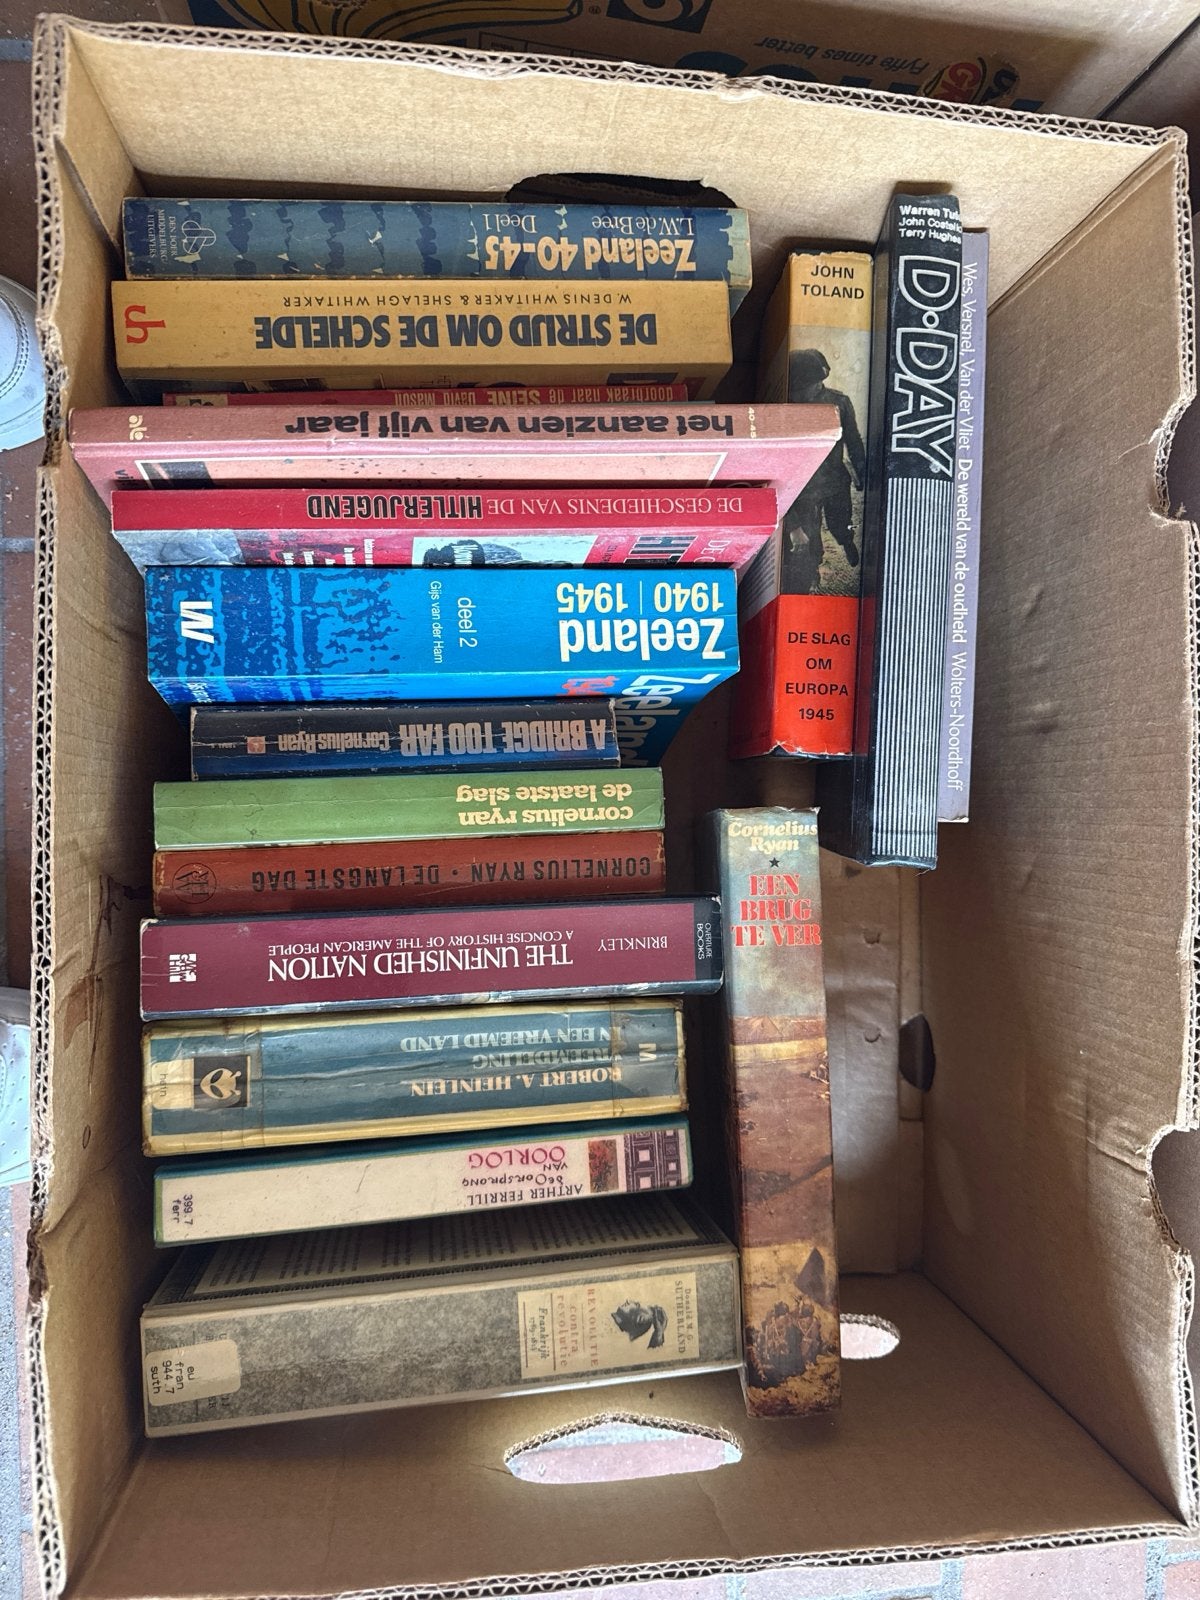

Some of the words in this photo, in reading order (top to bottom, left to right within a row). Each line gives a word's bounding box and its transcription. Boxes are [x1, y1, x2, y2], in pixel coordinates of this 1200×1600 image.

[755, 37, 818, 60] better
[822, 49, 877, 67] times
[881, 57, 929, 74] Fyffe
[898, 217, 925, 226] John
[899, 205, 940, 217] Warren
[494, 213, 536, 232] Deel
[591, 215, 633, 233] Bree
[635, 216, 656, 235] de
[658, 216, 694, 236] L.W.
[898, 228, 926, 239] Terry
[929, 229, 961, 244] Hughes
[485, 235, 578, 271] 40-45
[583, 237, 696, 272] Zeeland
[811, 264, 854, 279] JOHN
[961, 262, 978, 297] Wes,
[282, 296, 369, 307] WHITAKER
[376, 295, 452, 306] SHELAGH
[459, 295, 469, 305] &
[474, 294, 557, 305] WHITAKER
[562, 294, 611, 305] DENIS
[617, 293, 631, 304] W.
[801, 284, 864, 300] TOLAND
[254, 314, 391, 349] SCHELDE
[398, 315, 439, 348] DE
[446, 314, 503, 348] OM
[509, 313, 611, 347] STRIJD
[619, 313, 658, 347] DE
[958, 299, 977, 358] Versnel,
[960, 357, 976, 386] Van
[394, 392, 435, 406] Mason
[443, 390, 476, 405] David
[487, 389, 540, 405] SEINE
[548, 388, 565, 404] de
[571, 387, 600, 402] naar
[606, 386, 673, 404] doorbraak
[959, 390, 974, 415] der
[284, 411, 370, 438] jaar
[377, 412, 433, 439] vijf
[440, 415, 511, 436] van
[518, 415, 669, 437] aanzien
[676, 413, 733, 436] het
[957, 416, 974, 451] Vliet
[957, 458, 973, 480] De
[306, 494, 483, 520] HITLERJUGEND
[486, 498, 515, 515] DE
[517, 498, 562, 515] VAN
[566, 497, 712, 515] GESCHIEDENIS
[717, 497, 743, 513] DE
[955, 483, 971, 531] wereld
[955, 533, 968, 559] van
[954, 561, 970, 580] de
[430, 581, 442, 601] Gijs
[556, 581, 628, 614] 1945
[653, 582, 724, 613] 1940
[431, 603, 440, 618] van
[457, 596, 477, 634] deel
[952, 583, 969, 642] oudheid
[432, 619, 442, 638] der
[558, 616, 726, 662] Zeeland
[788, 632, 807, 643] DE
[812, 632, 850, 645] SLAG
[434, 639, 443, 664] Ham
[459, 636, 477, 648] 2
[806, 657, 832, 670] OM
[785, 682, 849, 696] EUROPA
[799, 708, 835, 720] 1945
[947, 651, 968, 791] Wolters-Noordhoff
[278, 731, 316, 754] Ryan
[317, 731, 390, 753] Cornelius
[398, 723, 444, 757] FAR
[447, 721, 497, 755] TOO
[501, 719, 587, 753] BRIDGE
[590, 719, 606, 750] A
[455, 784, 510, 806] slag
[515, 784, 597, 803] laatste
[603, 782, 633, 801] de
[458, 807, 517, 826] ryan
[521, 806, 634, 827] cornelius
[728, 820, 818, 838] Cornelius
[749, 836, 799, 854] Ryan
[304, 865, 405, 890] LANGSTE
[413, 864, 439, 885] DE
[471, 860, 525, 883] RYAN
[533, 856, 651, 881] CORNELIUS
[251, 869, 296, 893] DAG
[749, 873, 800, 896] EEN
[740, 899, 811, 921] BRUG
[323, 939, 393, 952] AMERICAN
[395, 937, 423, 949] THE
[426, 935, 443, 947] OF
[448, 933, 503, 946] HISTORY
[506, 931, 562, 943] CONCISE
[565, 930, 573, 940] A
[597, 935, 667, 951] BRINKLEY
[704, 922, 712, 958] OVERTURE
[731, 924, 765, 947] TE
[771, 923, 822, 947] VER
[268, 943, 320, 956] PEOPLE
[525, 943, 573, 967] THE
[267, 953, 367, 982] NATION
[373, 946, 519, 975] UNFINISHED
[398, 1035, 460, 1052] LAND
[463, 1027, 553, 1050] VREEMD
[555, 1027, 594, 1043] EEN
[599, 1025, 622, 1043] IN
[410, 1075, 511, 1096] HEINLEIN
[516, 1073, 534, 1088] A.
[539, 1065, 623, 1087] ROBERT
[468, 1146, 565, 1170] OORLOG
[466, 1191, 523, 1206] FERRILL
[530, 1184, 583, 1199] ARTHER
[172, 1199, 182, 1223] ferr
[183, 1194, 193, 1225] 399.7
[675, 1280, 686, 1354] SUTHERLAND
[538, 1307, 550, 1360] Frankrijk
[557, 1294, 570, 1367] revolutie
[569, 1305, 579, 1353] contra
[150, 1366, 161, 1394] suth
[174, 1361, 185, 1390] fran
[186, 1366, 196, 1381] eu
